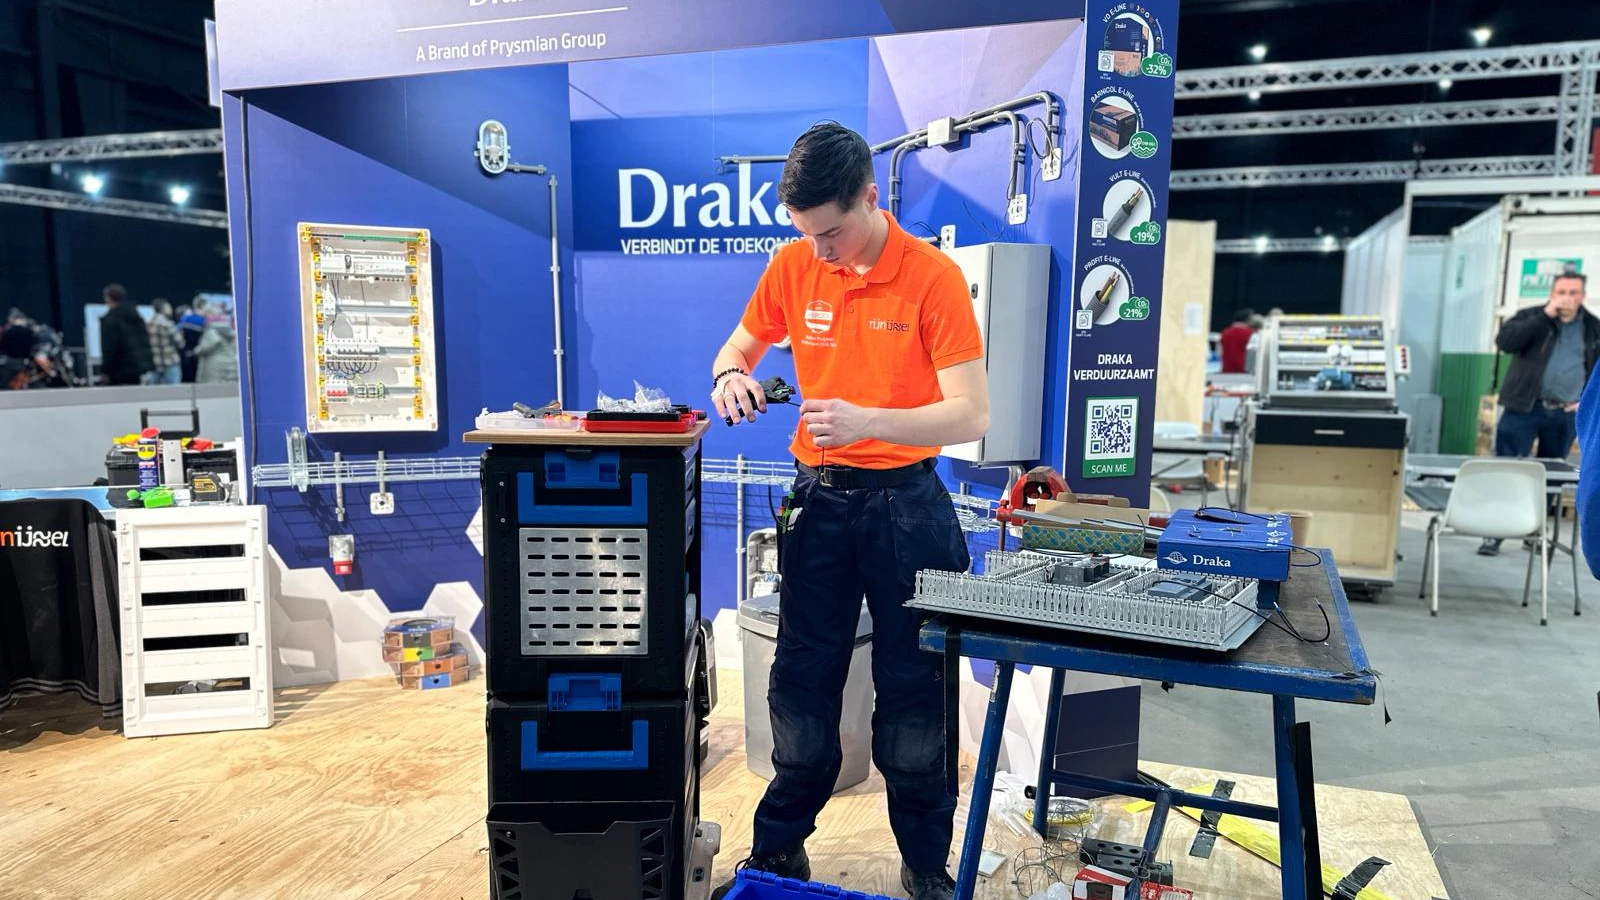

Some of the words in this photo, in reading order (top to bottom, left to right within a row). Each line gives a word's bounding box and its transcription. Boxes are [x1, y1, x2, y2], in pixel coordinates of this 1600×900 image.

[1102, 14, 1111, 23] VD
[1110, 3, 1127, 16] E-LINE
[416, 46, 426, 62] A
[428, 42, 469, 61] Brand
[472, 39, 488, 57] of
[490, 34, 558, 57] Prysmian
[561, 32, 607, 50] Group
[1146, 64, 1167, 75] -32%
[1090, 86, 1117, 103] BARNICOL
[1118, 87, 1135, 101] E-LINE
[1109, 170, 1123, 182] VULT
[1123, 169, 1142, 180] E-LINE
[1134, 231, 1156, 242] -19%
[621, 239, 695, 255] VERBINDT
[700, 238, 720, 254] DE
[1084, 255, 1103, 271] PROFIT
[1104, 255, 1122, 265] E-LINE
[1123, 308, 1143, 318] -21%
[1097, 353, 1133, 365] DRAKA
[1073, 368, 1155, 380] VERDUURZAAMT
[1091, 464, 1113, 474] SCAN
[1114, 463, 1127, 473] ME
[1193, 554, 1232, 568] Draka
